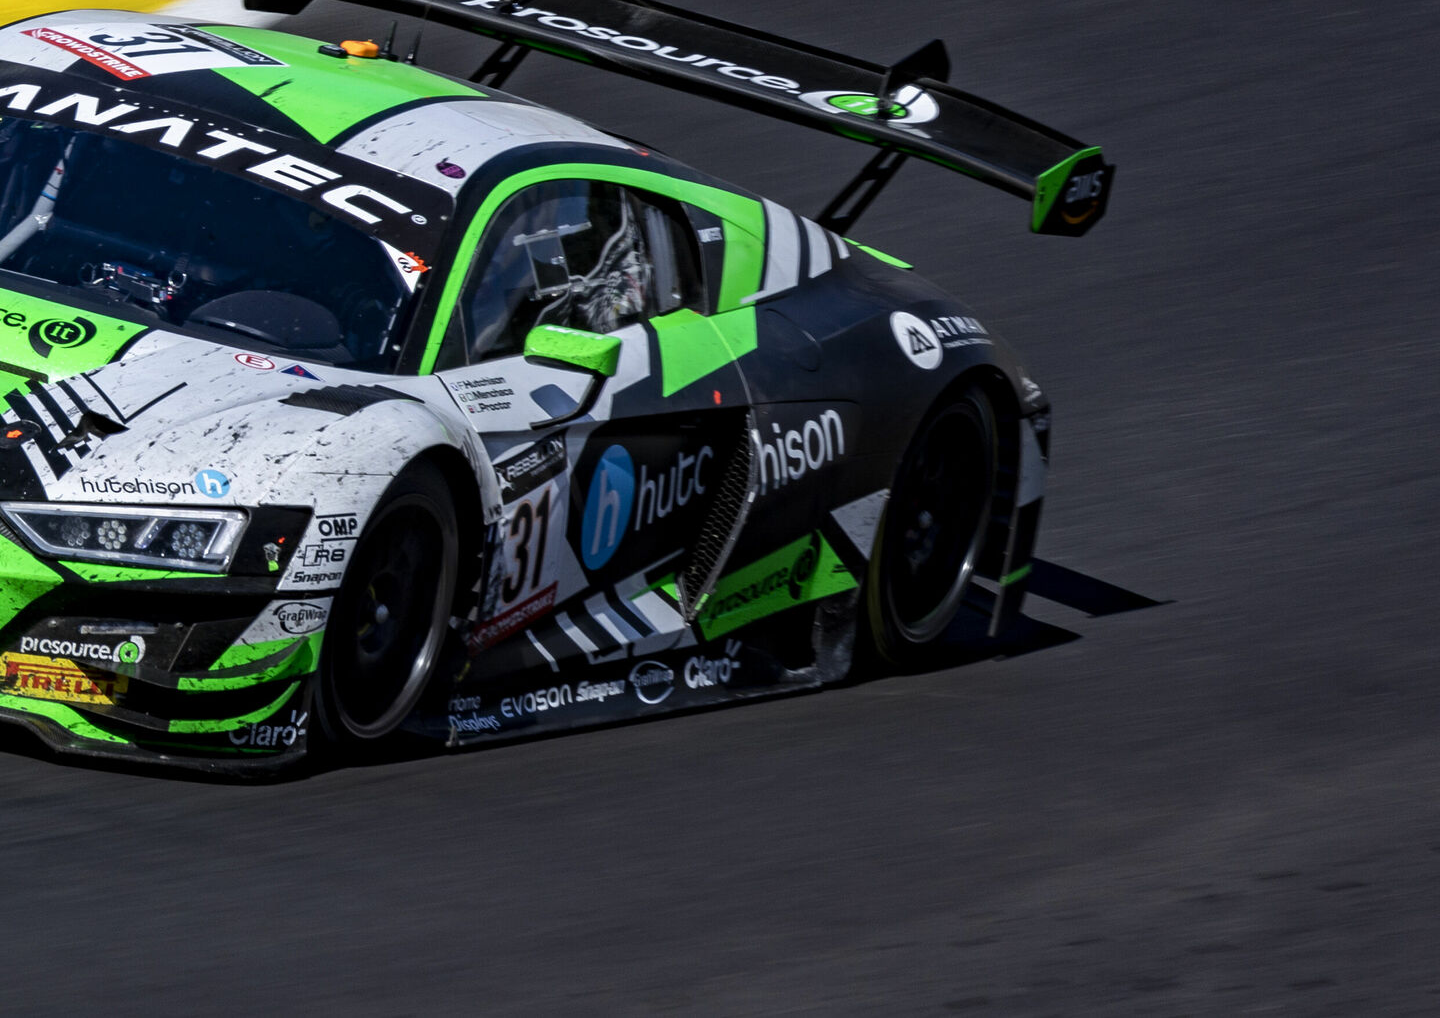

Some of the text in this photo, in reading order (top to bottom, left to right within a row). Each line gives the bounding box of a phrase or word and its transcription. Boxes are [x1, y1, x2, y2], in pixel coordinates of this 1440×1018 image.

[40, 30, 143, 78] CROWDSTRIKE
[89, 32, 213, 57] 31
[51, 321, 73, 341] it
[80, 476, 196, 495] hutchison
[318, 518, 358, 537] OMP
[314, 548, 346, 564] R8
[502, 487, 552, 606] 31
[228, 723, 297, 747] Claro
